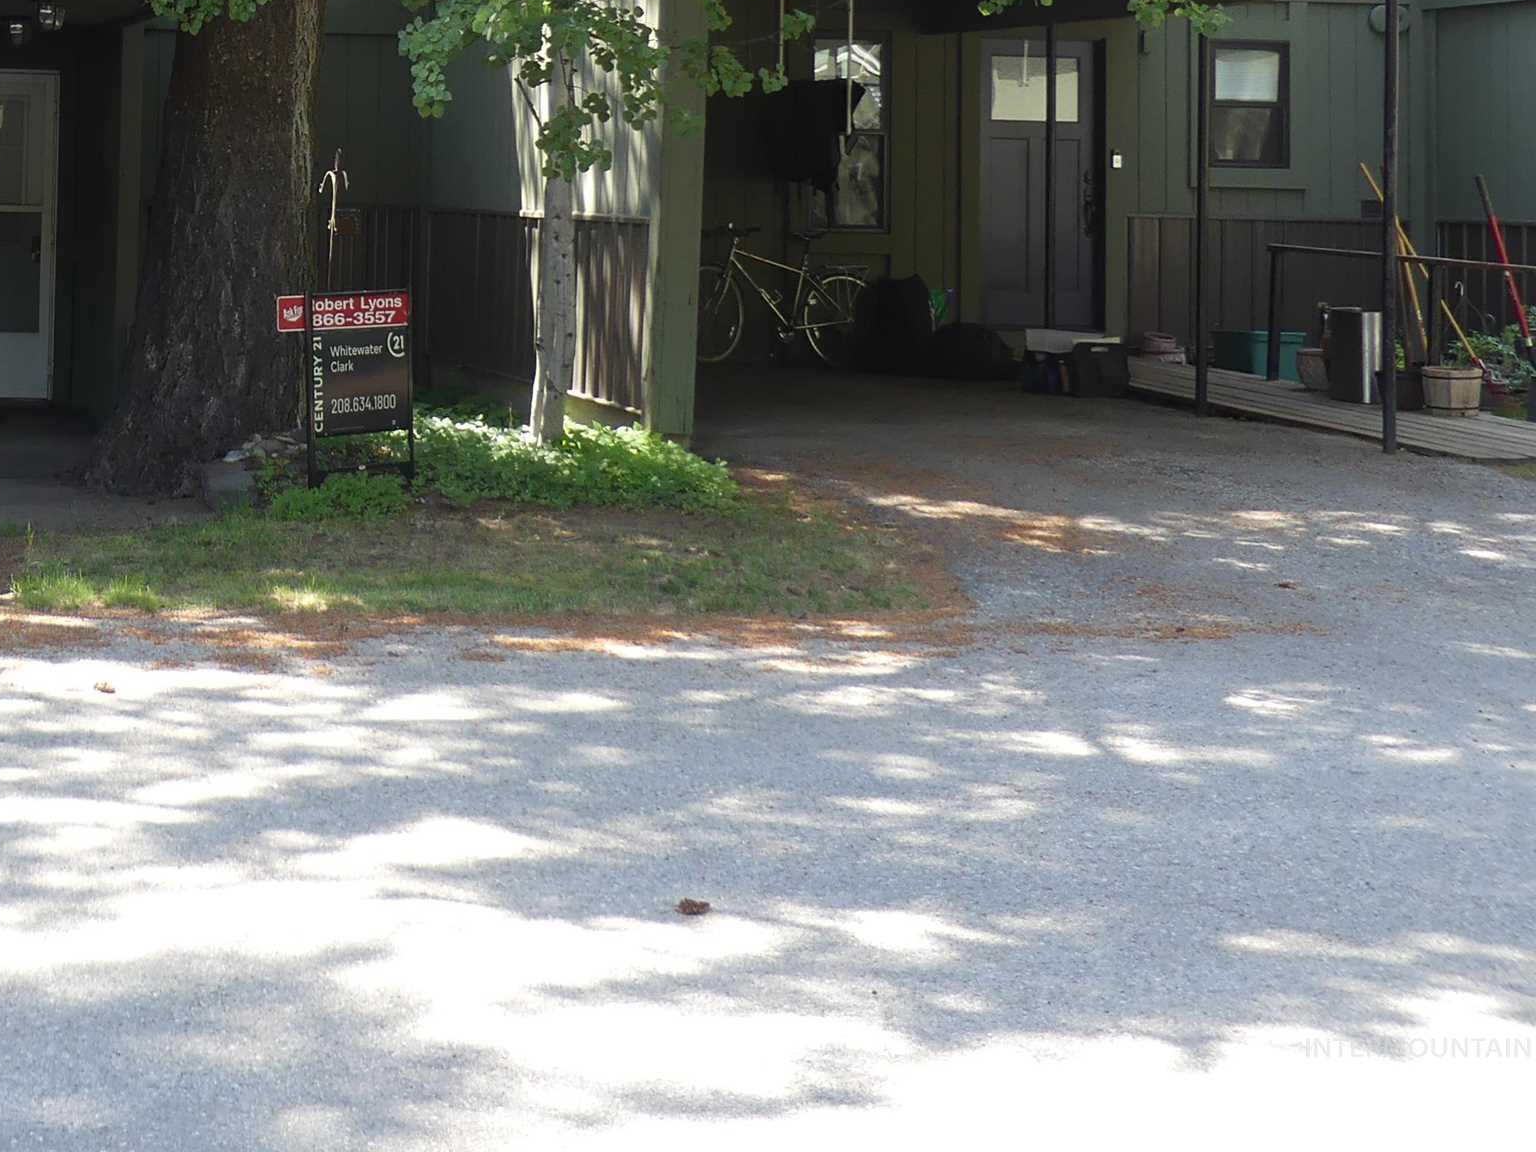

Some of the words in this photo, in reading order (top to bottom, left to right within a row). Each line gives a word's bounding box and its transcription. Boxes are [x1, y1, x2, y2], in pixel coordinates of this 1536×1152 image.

[312, 298, 354, 311] obert
[360, 296, 402, 312] Lyons
[312, 310, 396, 327] 866-3557
[313, 336, 322, 351] 21
[330, 344, 383, 358] Whitewater
[330, 362, 354, 374] Clark
[313, 356, 324, 433] CENTURY
[330, 394, 396, 415] 208.634.1800
